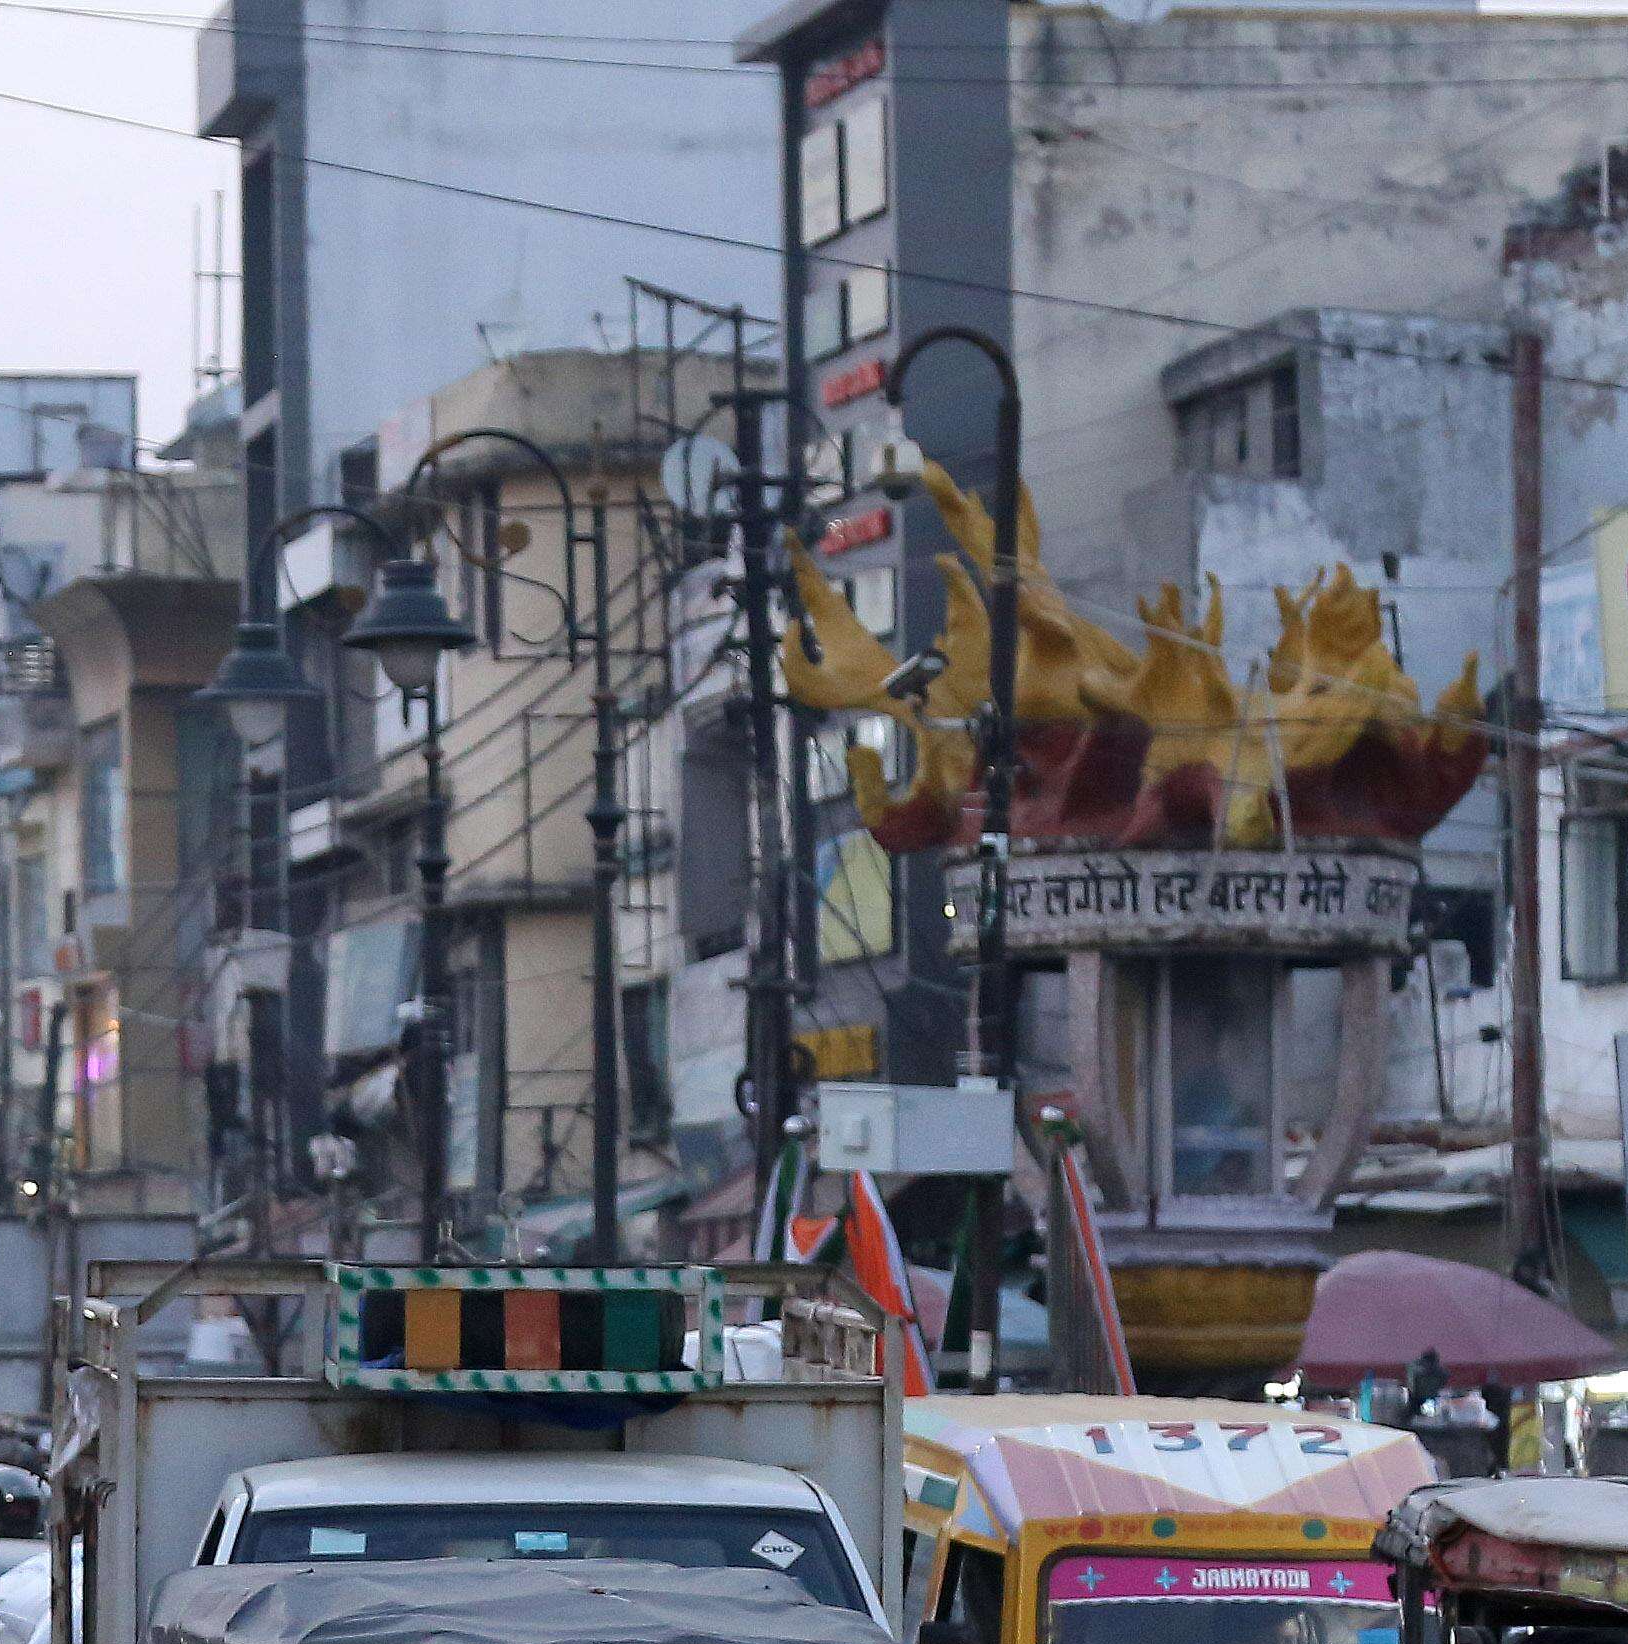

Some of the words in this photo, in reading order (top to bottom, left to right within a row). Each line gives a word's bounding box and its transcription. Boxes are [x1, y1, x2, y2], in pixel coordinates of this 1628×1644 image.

[1151, 871, 1196, 915] हर
[1085, 1422, 1349, 1456] 1372
[761, 1544, 793, 1554] CNG
